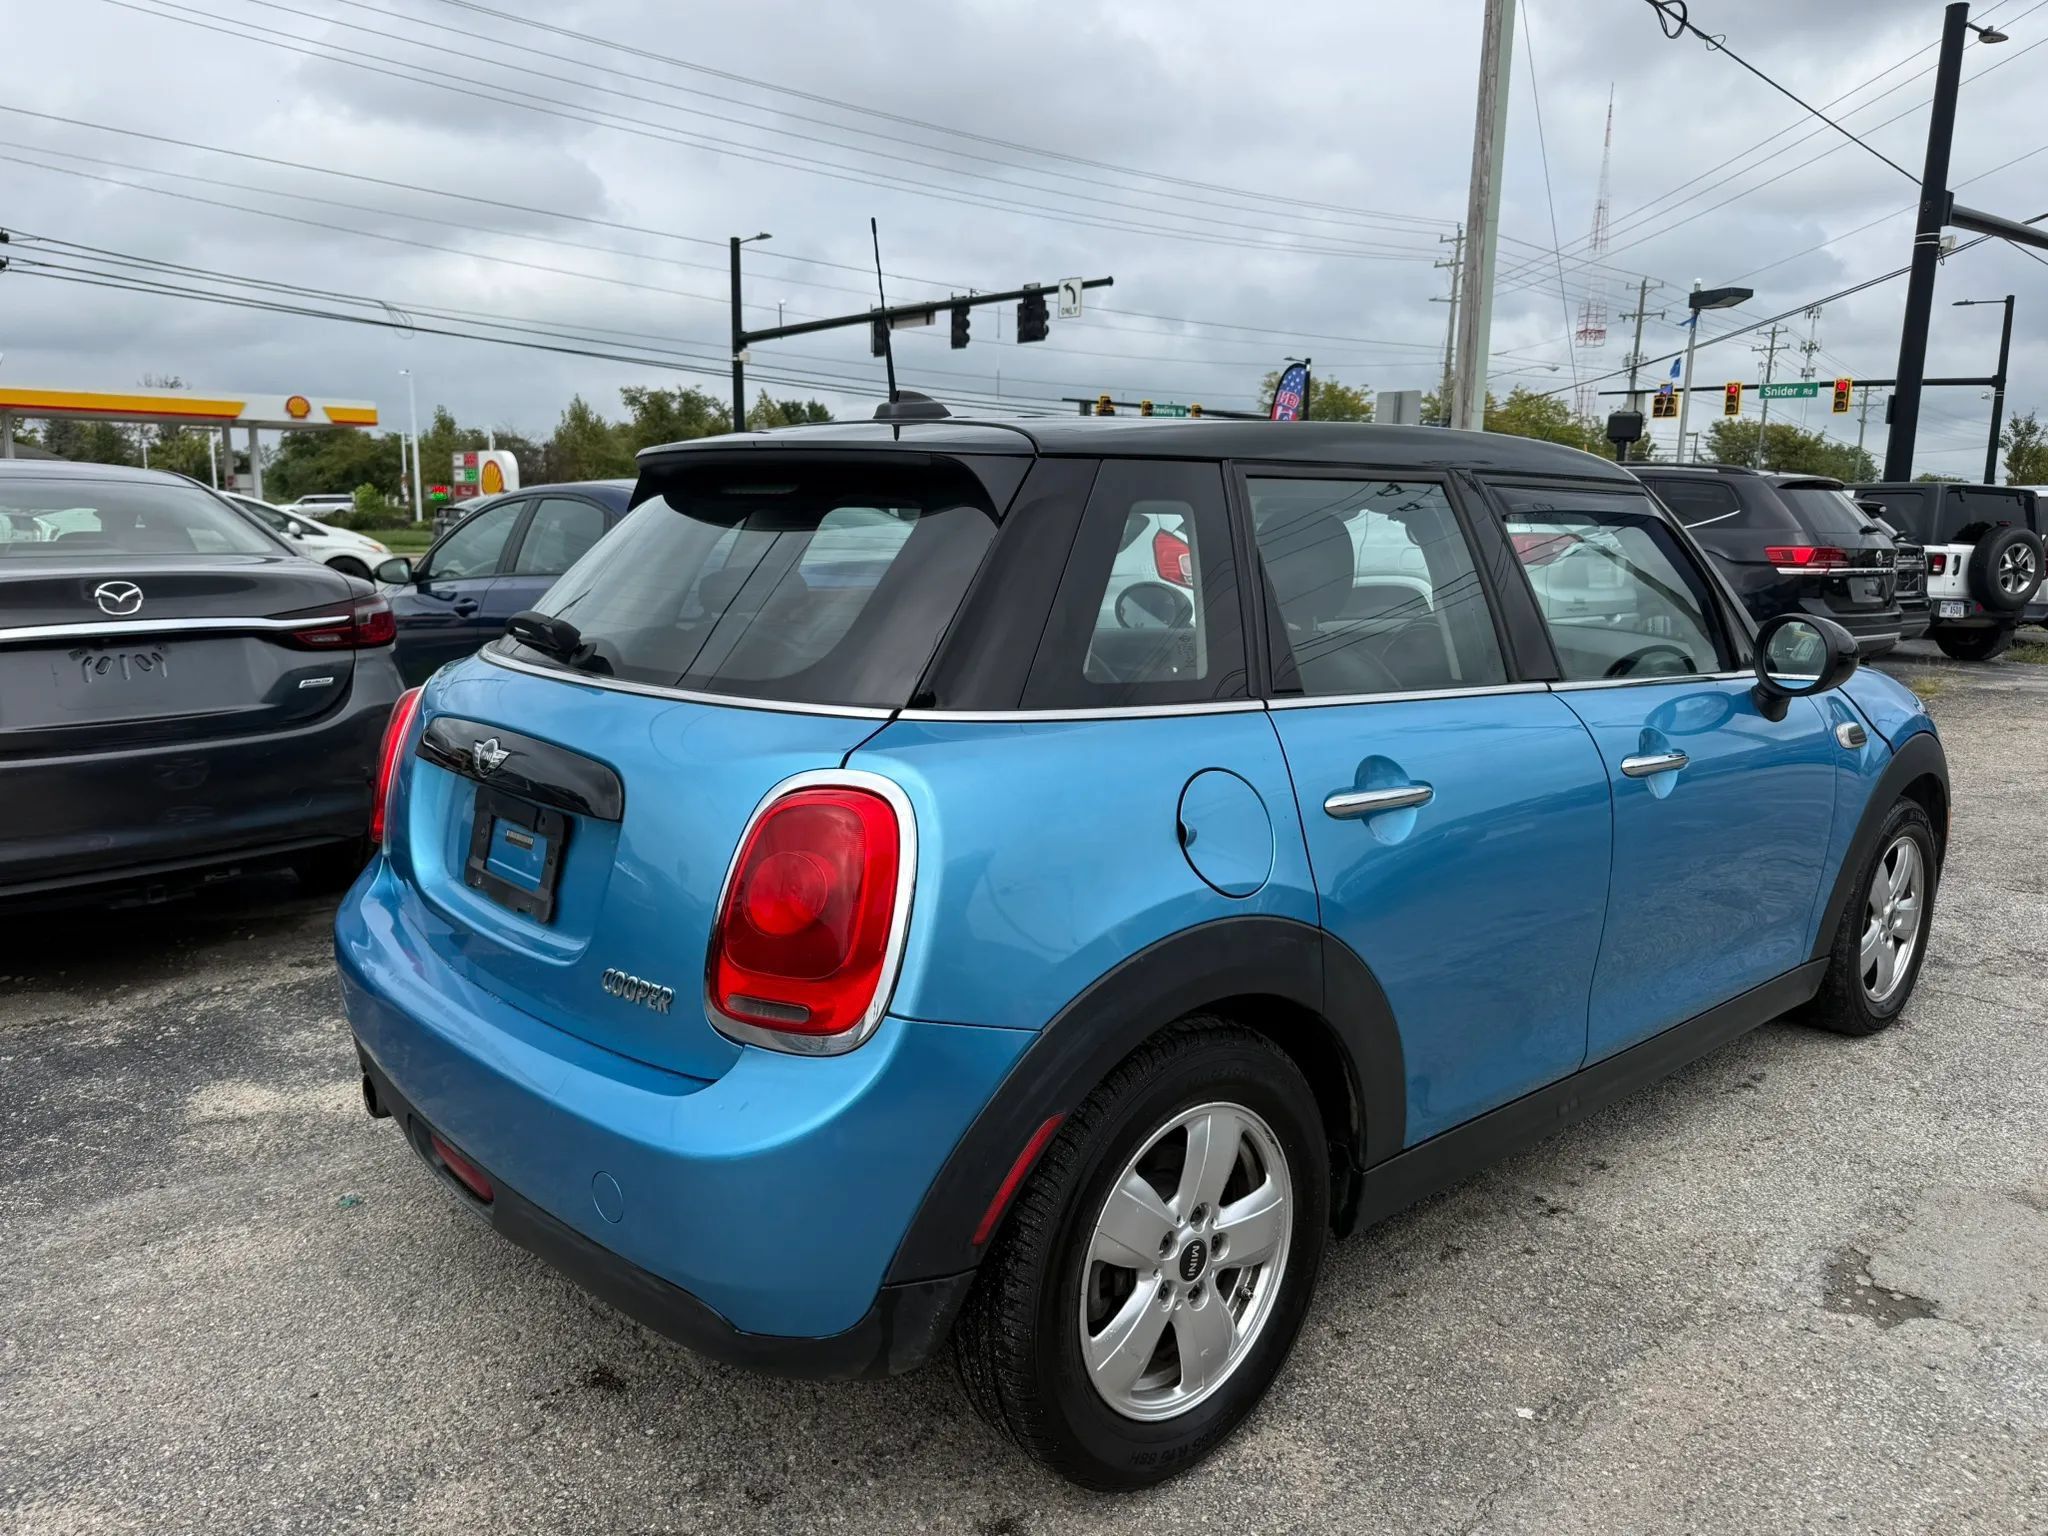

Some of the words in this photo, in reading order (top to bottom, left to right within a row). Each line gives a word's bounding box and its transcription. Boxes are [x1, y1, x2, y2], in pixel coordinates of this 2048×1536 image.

[1764, 386, 1798, 397] Snider
[1802, 387, 1814, 396] Rd
[602, 967, 674, 1015] COOPER
[1187, 1245, 1200, 1277] MINI
